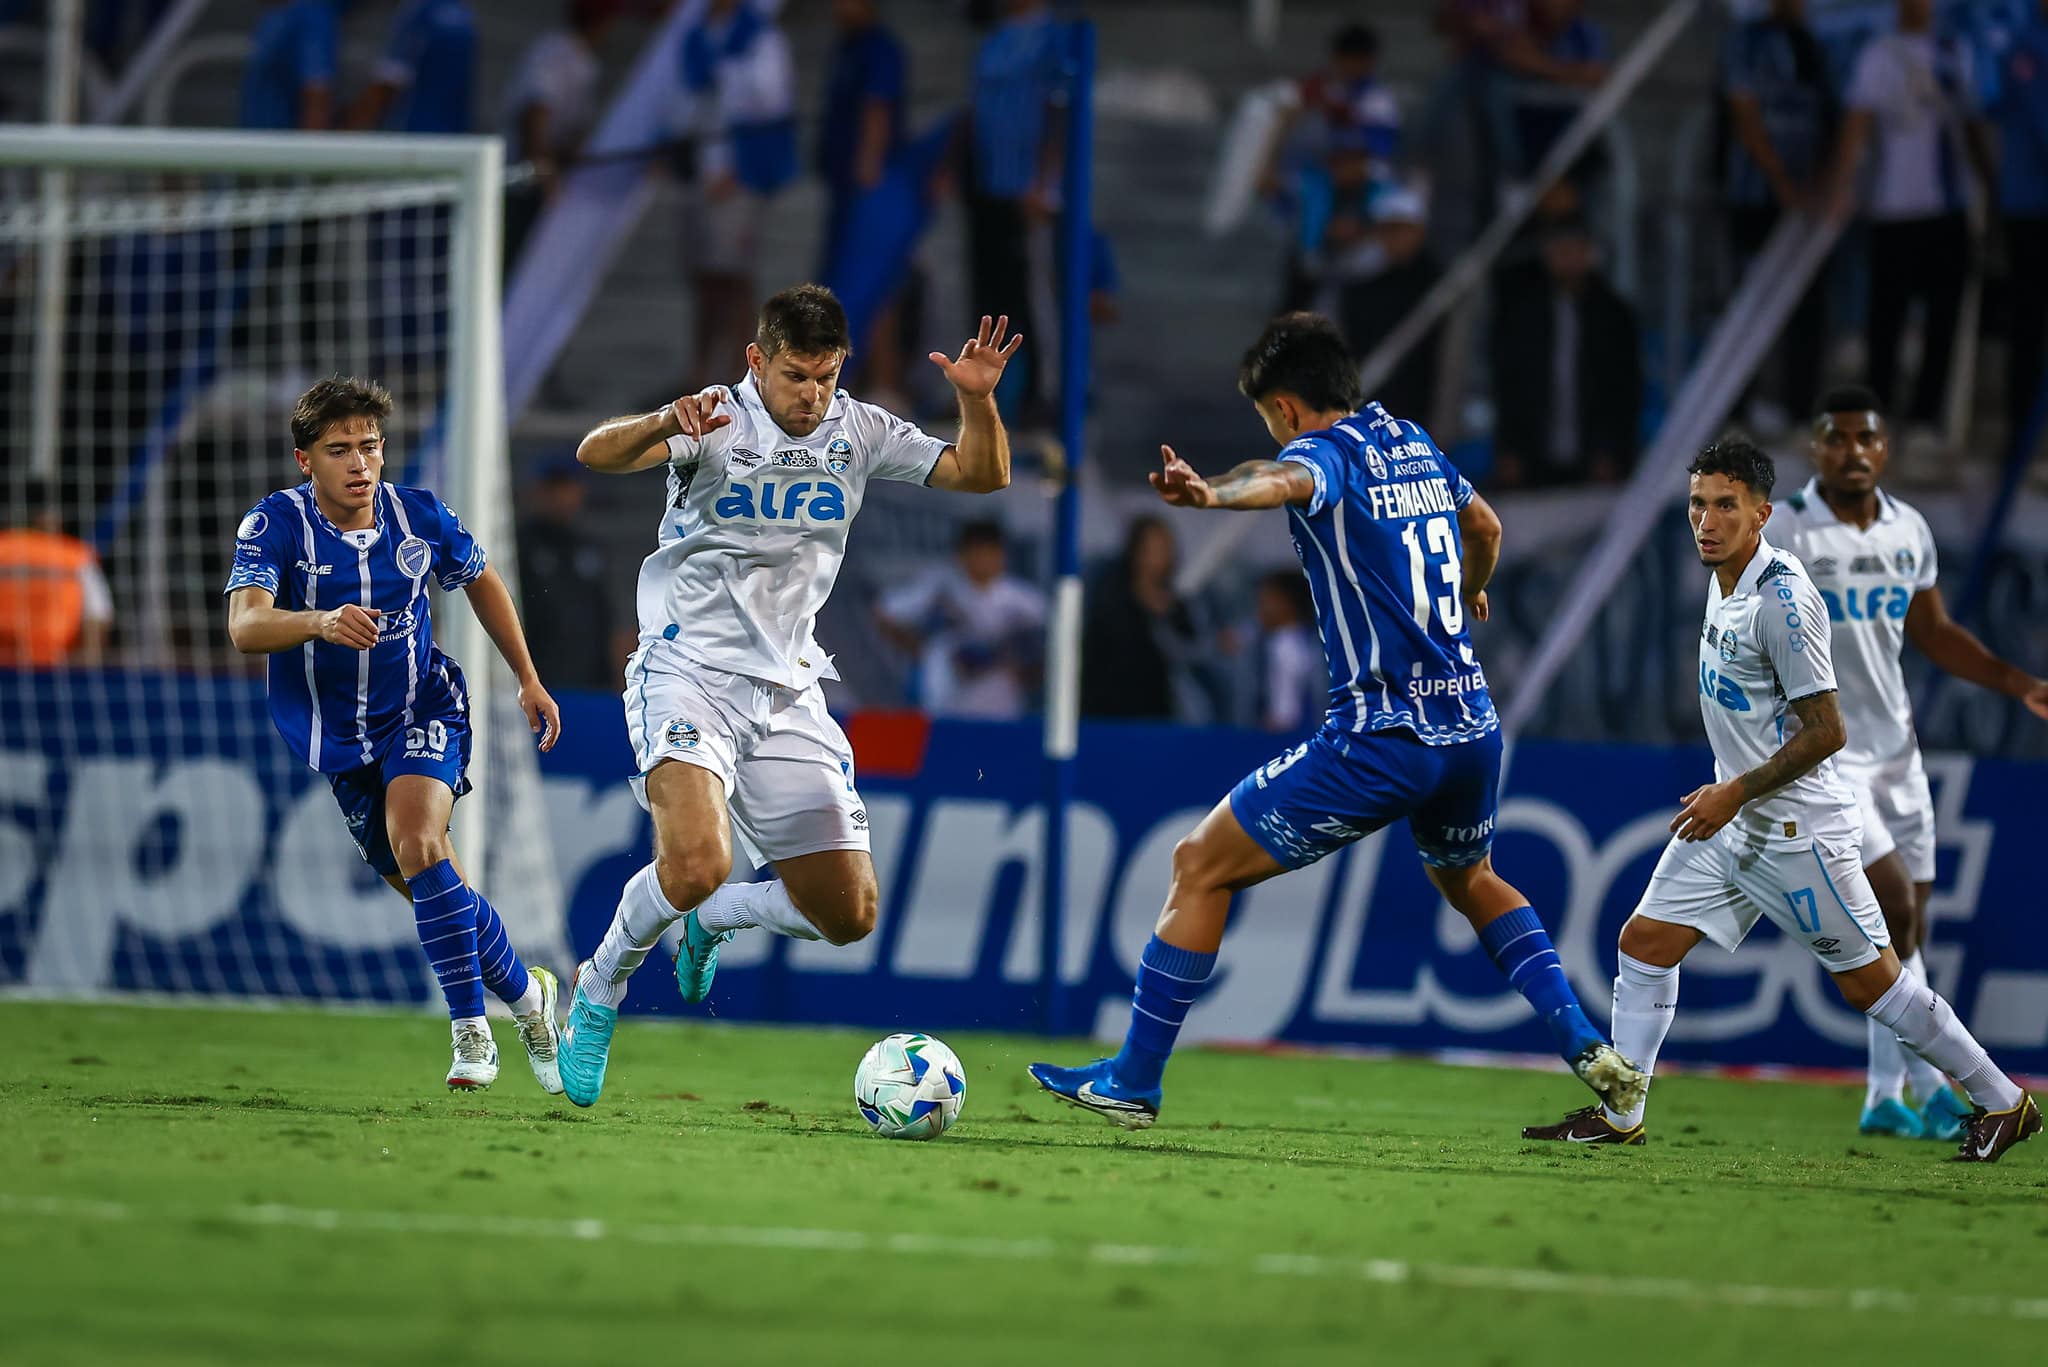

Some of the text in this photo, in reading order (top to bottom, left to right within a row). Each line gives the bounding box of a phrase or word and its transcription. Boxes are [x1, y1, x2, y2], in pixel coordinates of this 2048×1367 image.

[731, 456, 757, 469] umbro
[715, 481, 846, 521] alfa
[295, 559, 334, 576] FIUME
[1401, 516, 1463, 636] 13
[403, 750, 445, 762] FIUME
[1783, 887, 1821, 933] 17
